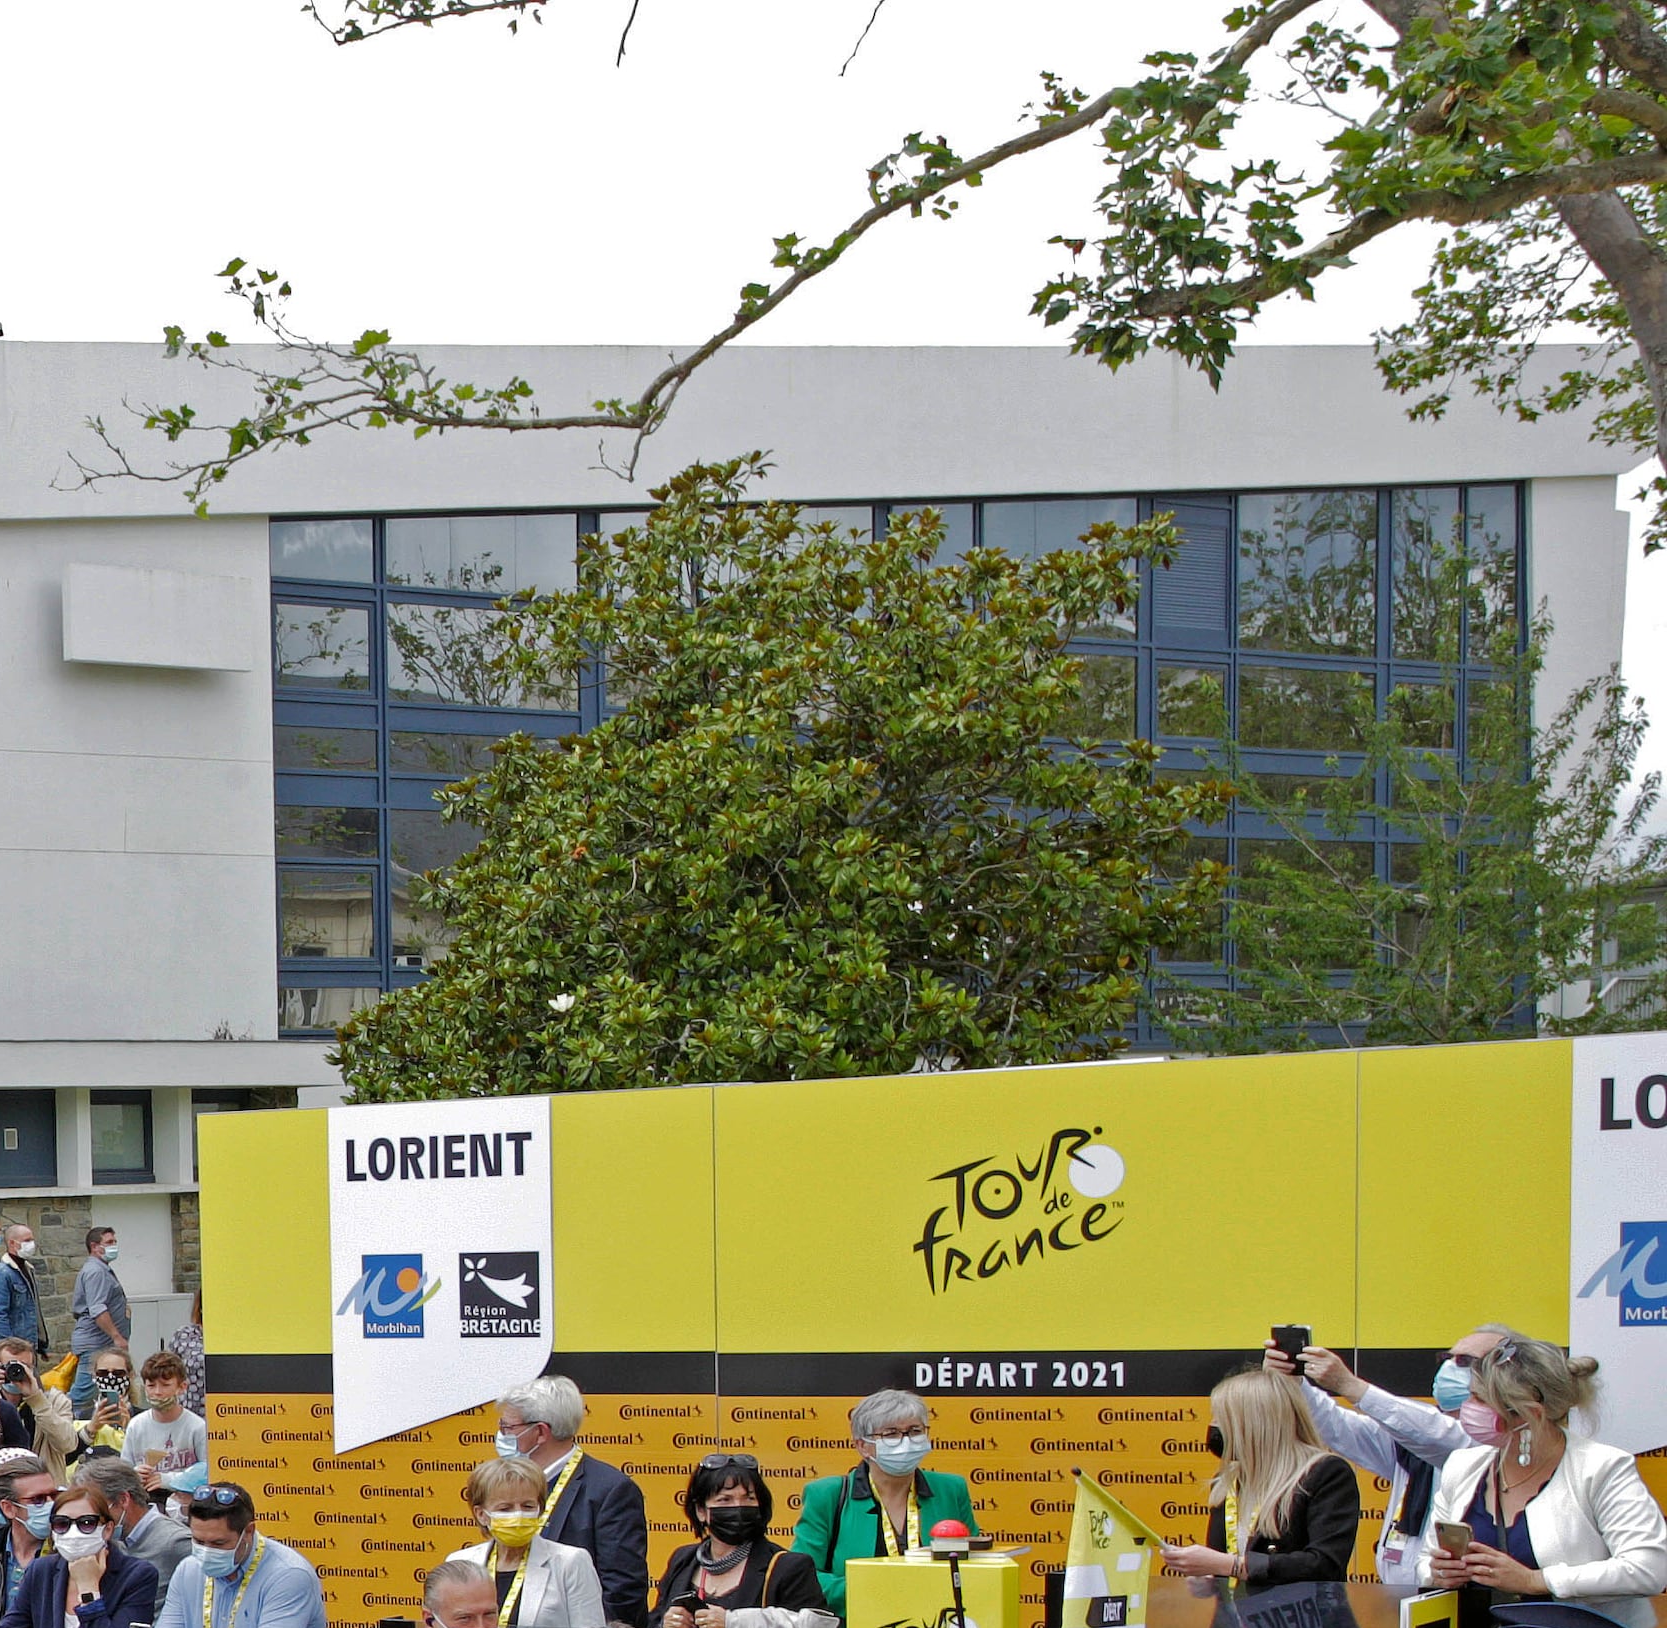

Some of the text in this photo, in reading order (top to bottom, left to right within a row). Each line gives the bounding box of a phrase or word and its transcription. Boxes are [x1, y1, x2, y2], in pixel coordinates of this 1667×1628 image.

[346, 1132, 532, 1182] LORIENT
[927, 1125, 1104, 1231] TOUR
[1045, 1188, 1072, 1215] de
[914, 1201, 1125, 1296] france
[464, 1304, 506, 1317] Région
[366, 1322, 420, 1334] Morbihan
[460, 1318, 541, 1334] BRETAGNE
[915, 1357, 1125, 1388] DÉPART 2021
[216, 1403, 277, 1417] Continental
[619, 1404, 690, 1420] Continental
[731, 1406, 805, 1423] Continental
[970, 1408, 1051, 1424] Continental
[1098, 1408, 1183, 1425] Continental
[261, 1429, 323, 1443] Continental
[673, 1432, 745, 1448] Continental
[1030, 1437, 1113, 1454] Continental
[218, 1456, 279, 1470] Continental
[313, 1457, 376, 1472] Continental
[970, 1468, 1051, 1484] Continental
[1097, 1469, 1182, 1486] Continental
[263, 1482, 325, 1497] Continental
[360, 1484, 424, 1499] Continental
[314, 1511, 377, 1525] Continental
[361, 1538, 425, 1553] Continental
